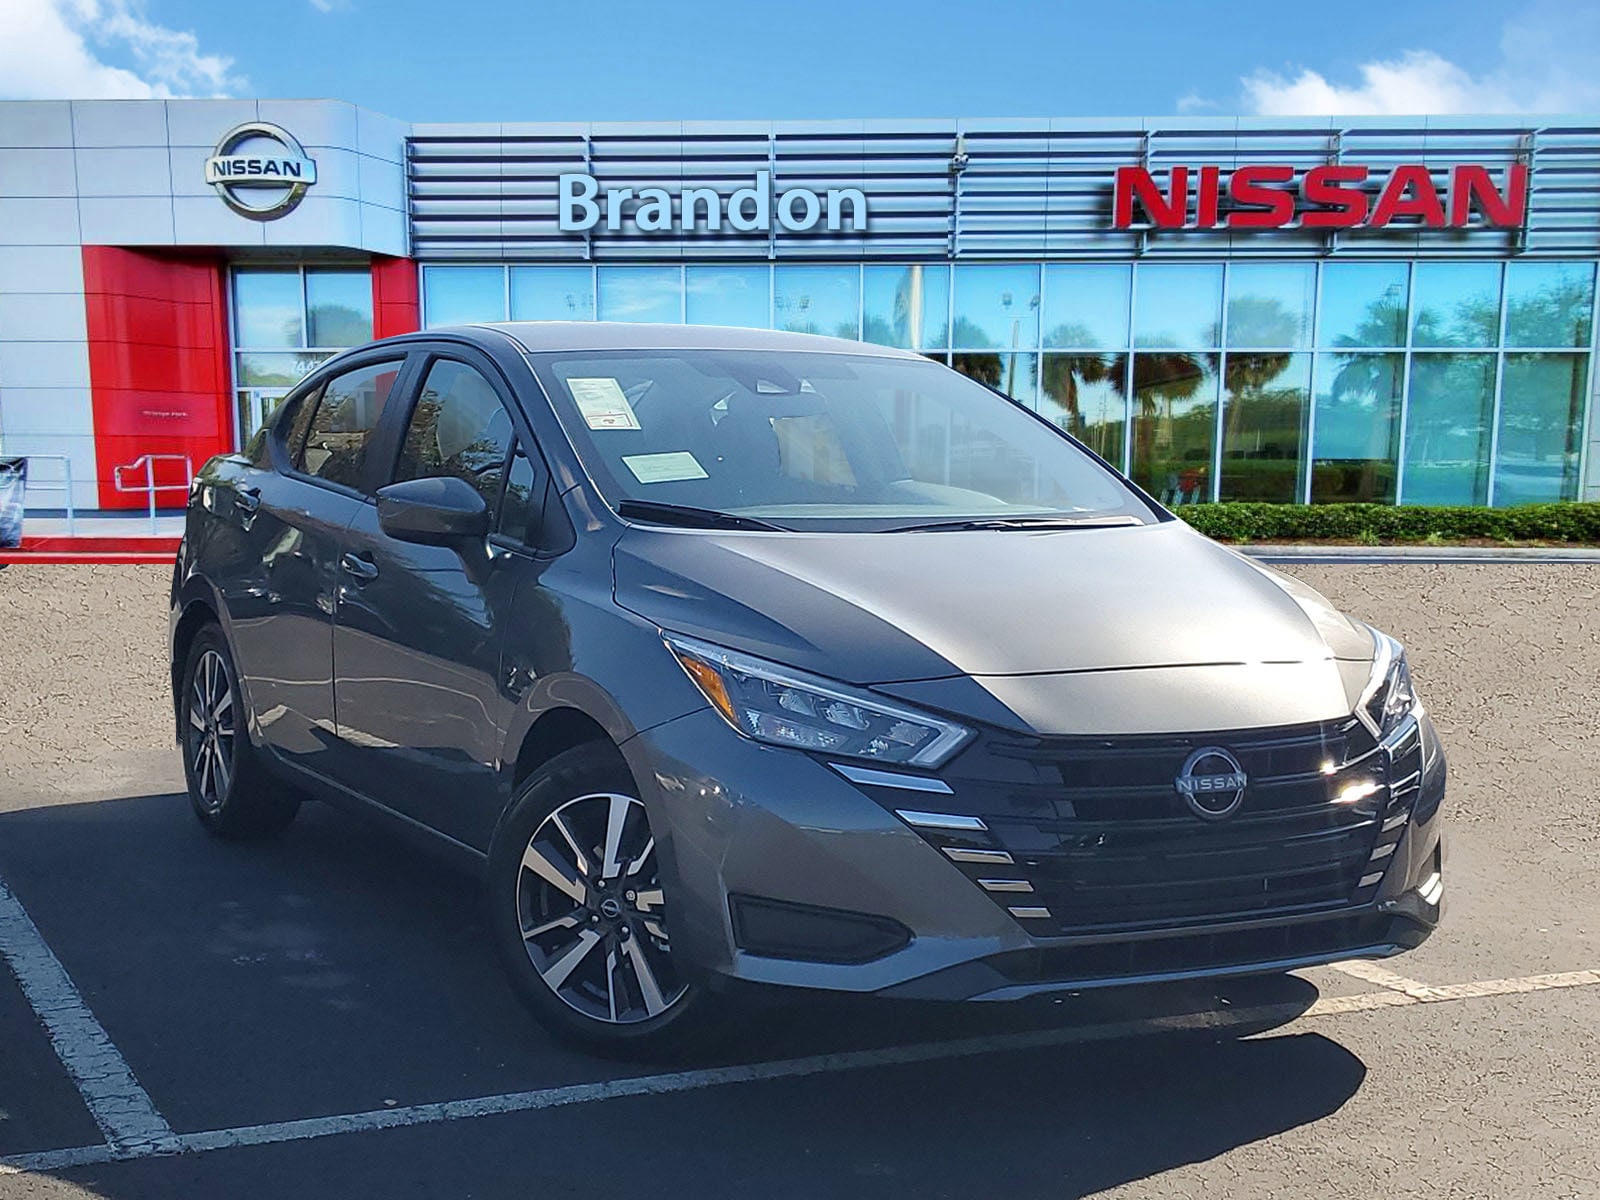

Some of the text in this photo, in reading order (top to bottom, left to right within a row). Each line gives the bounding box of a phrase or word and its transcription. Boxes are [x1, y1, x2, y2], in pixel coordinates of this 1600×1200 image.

[213, 160, 301, 177] NISSAN
[559, 170, 867, 231] Brandon
[1112, 165, 1529, 229] NISSAN
[1178, 774, 1247, 793] NISSAN
